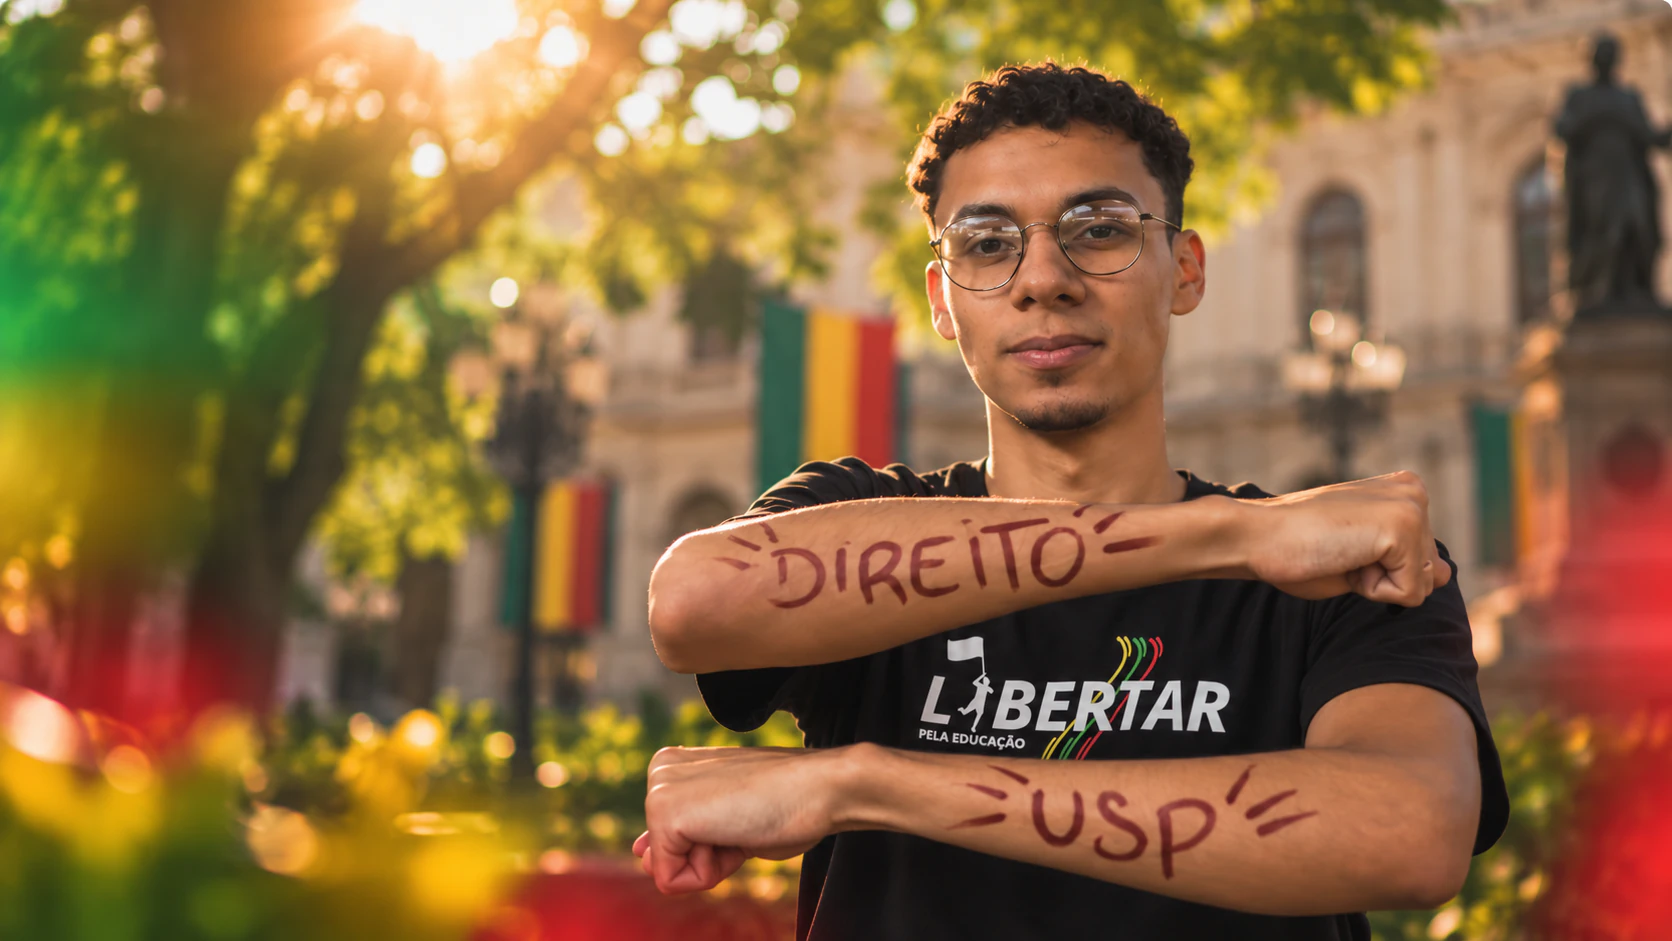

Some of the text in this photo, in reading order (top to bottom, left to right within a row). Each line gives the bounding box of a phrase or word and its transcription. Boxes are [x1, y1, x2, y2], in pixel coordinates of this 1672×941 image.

[919, 729, 1025, 750] PELA EDUCAÇÃO
[1031, 788, 1217, 880] USP
